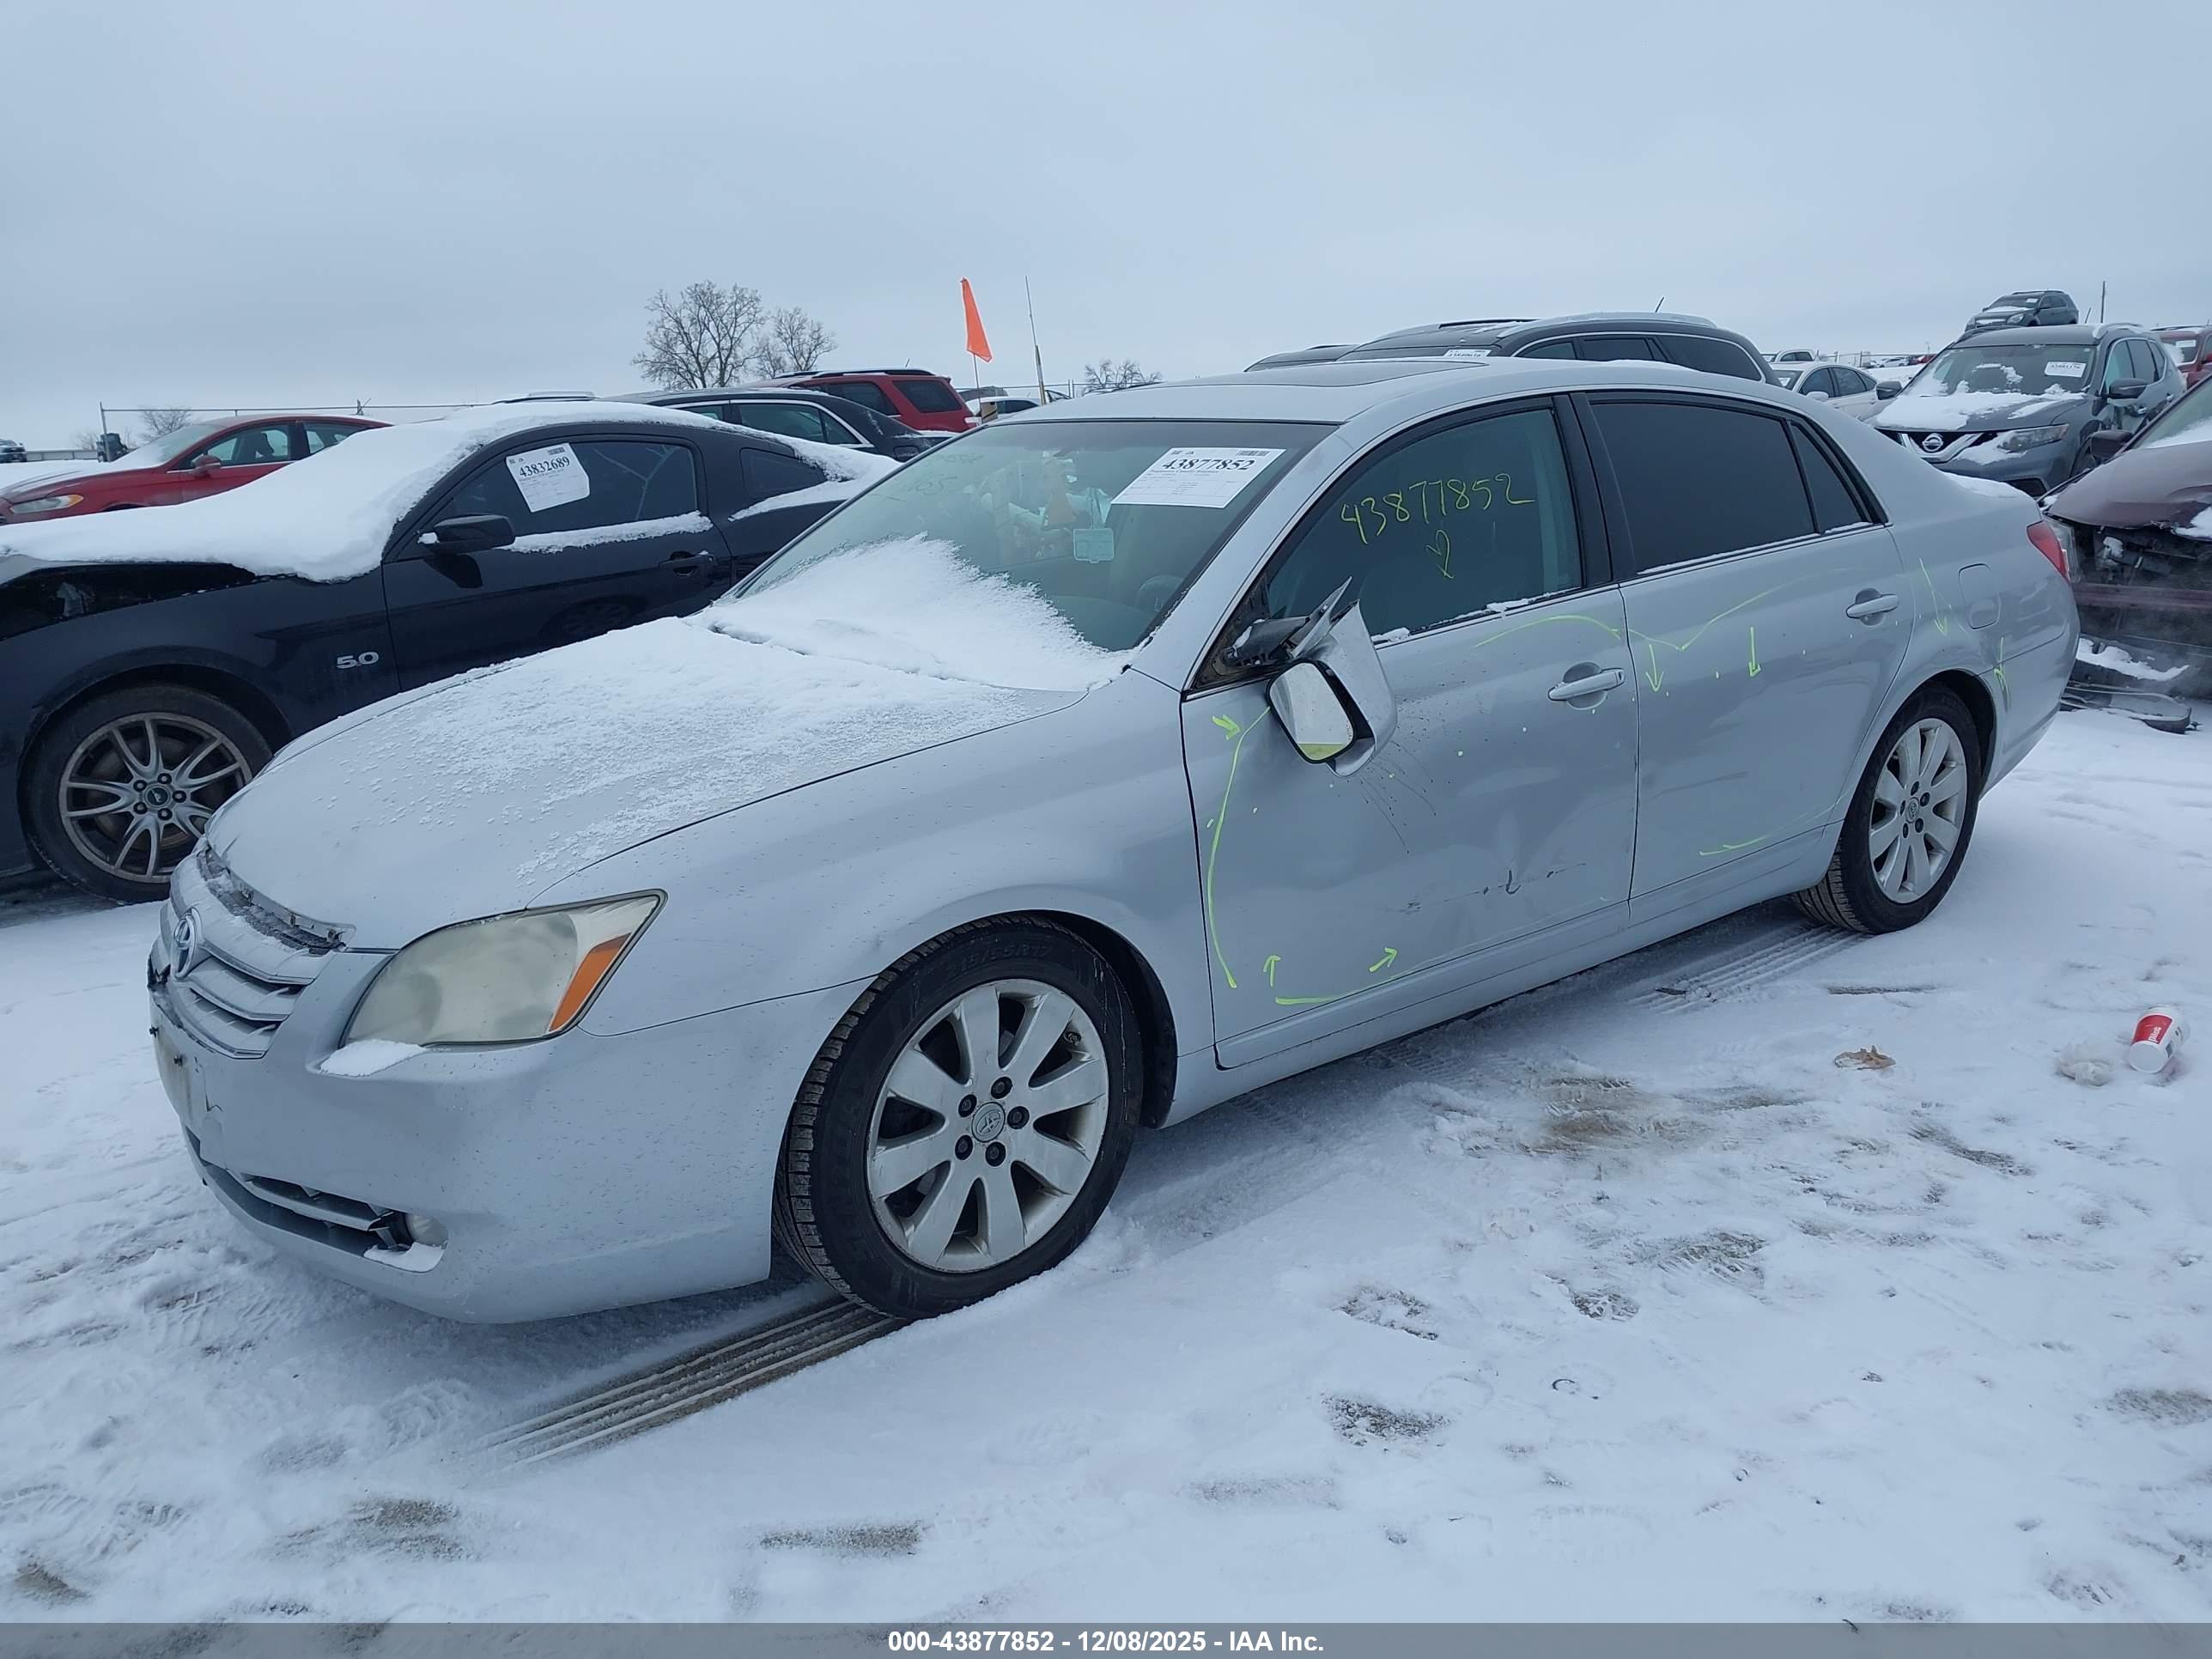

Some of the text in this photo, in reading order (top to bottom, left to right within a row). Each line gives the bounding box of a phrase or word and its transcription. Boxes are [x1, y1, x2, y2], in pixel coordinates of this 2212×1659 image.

[519, 456, 570, 477] 43832689
[1162, 459, 1255, 471] 43877852
[1340, 472, 1535, 544] 43877852
